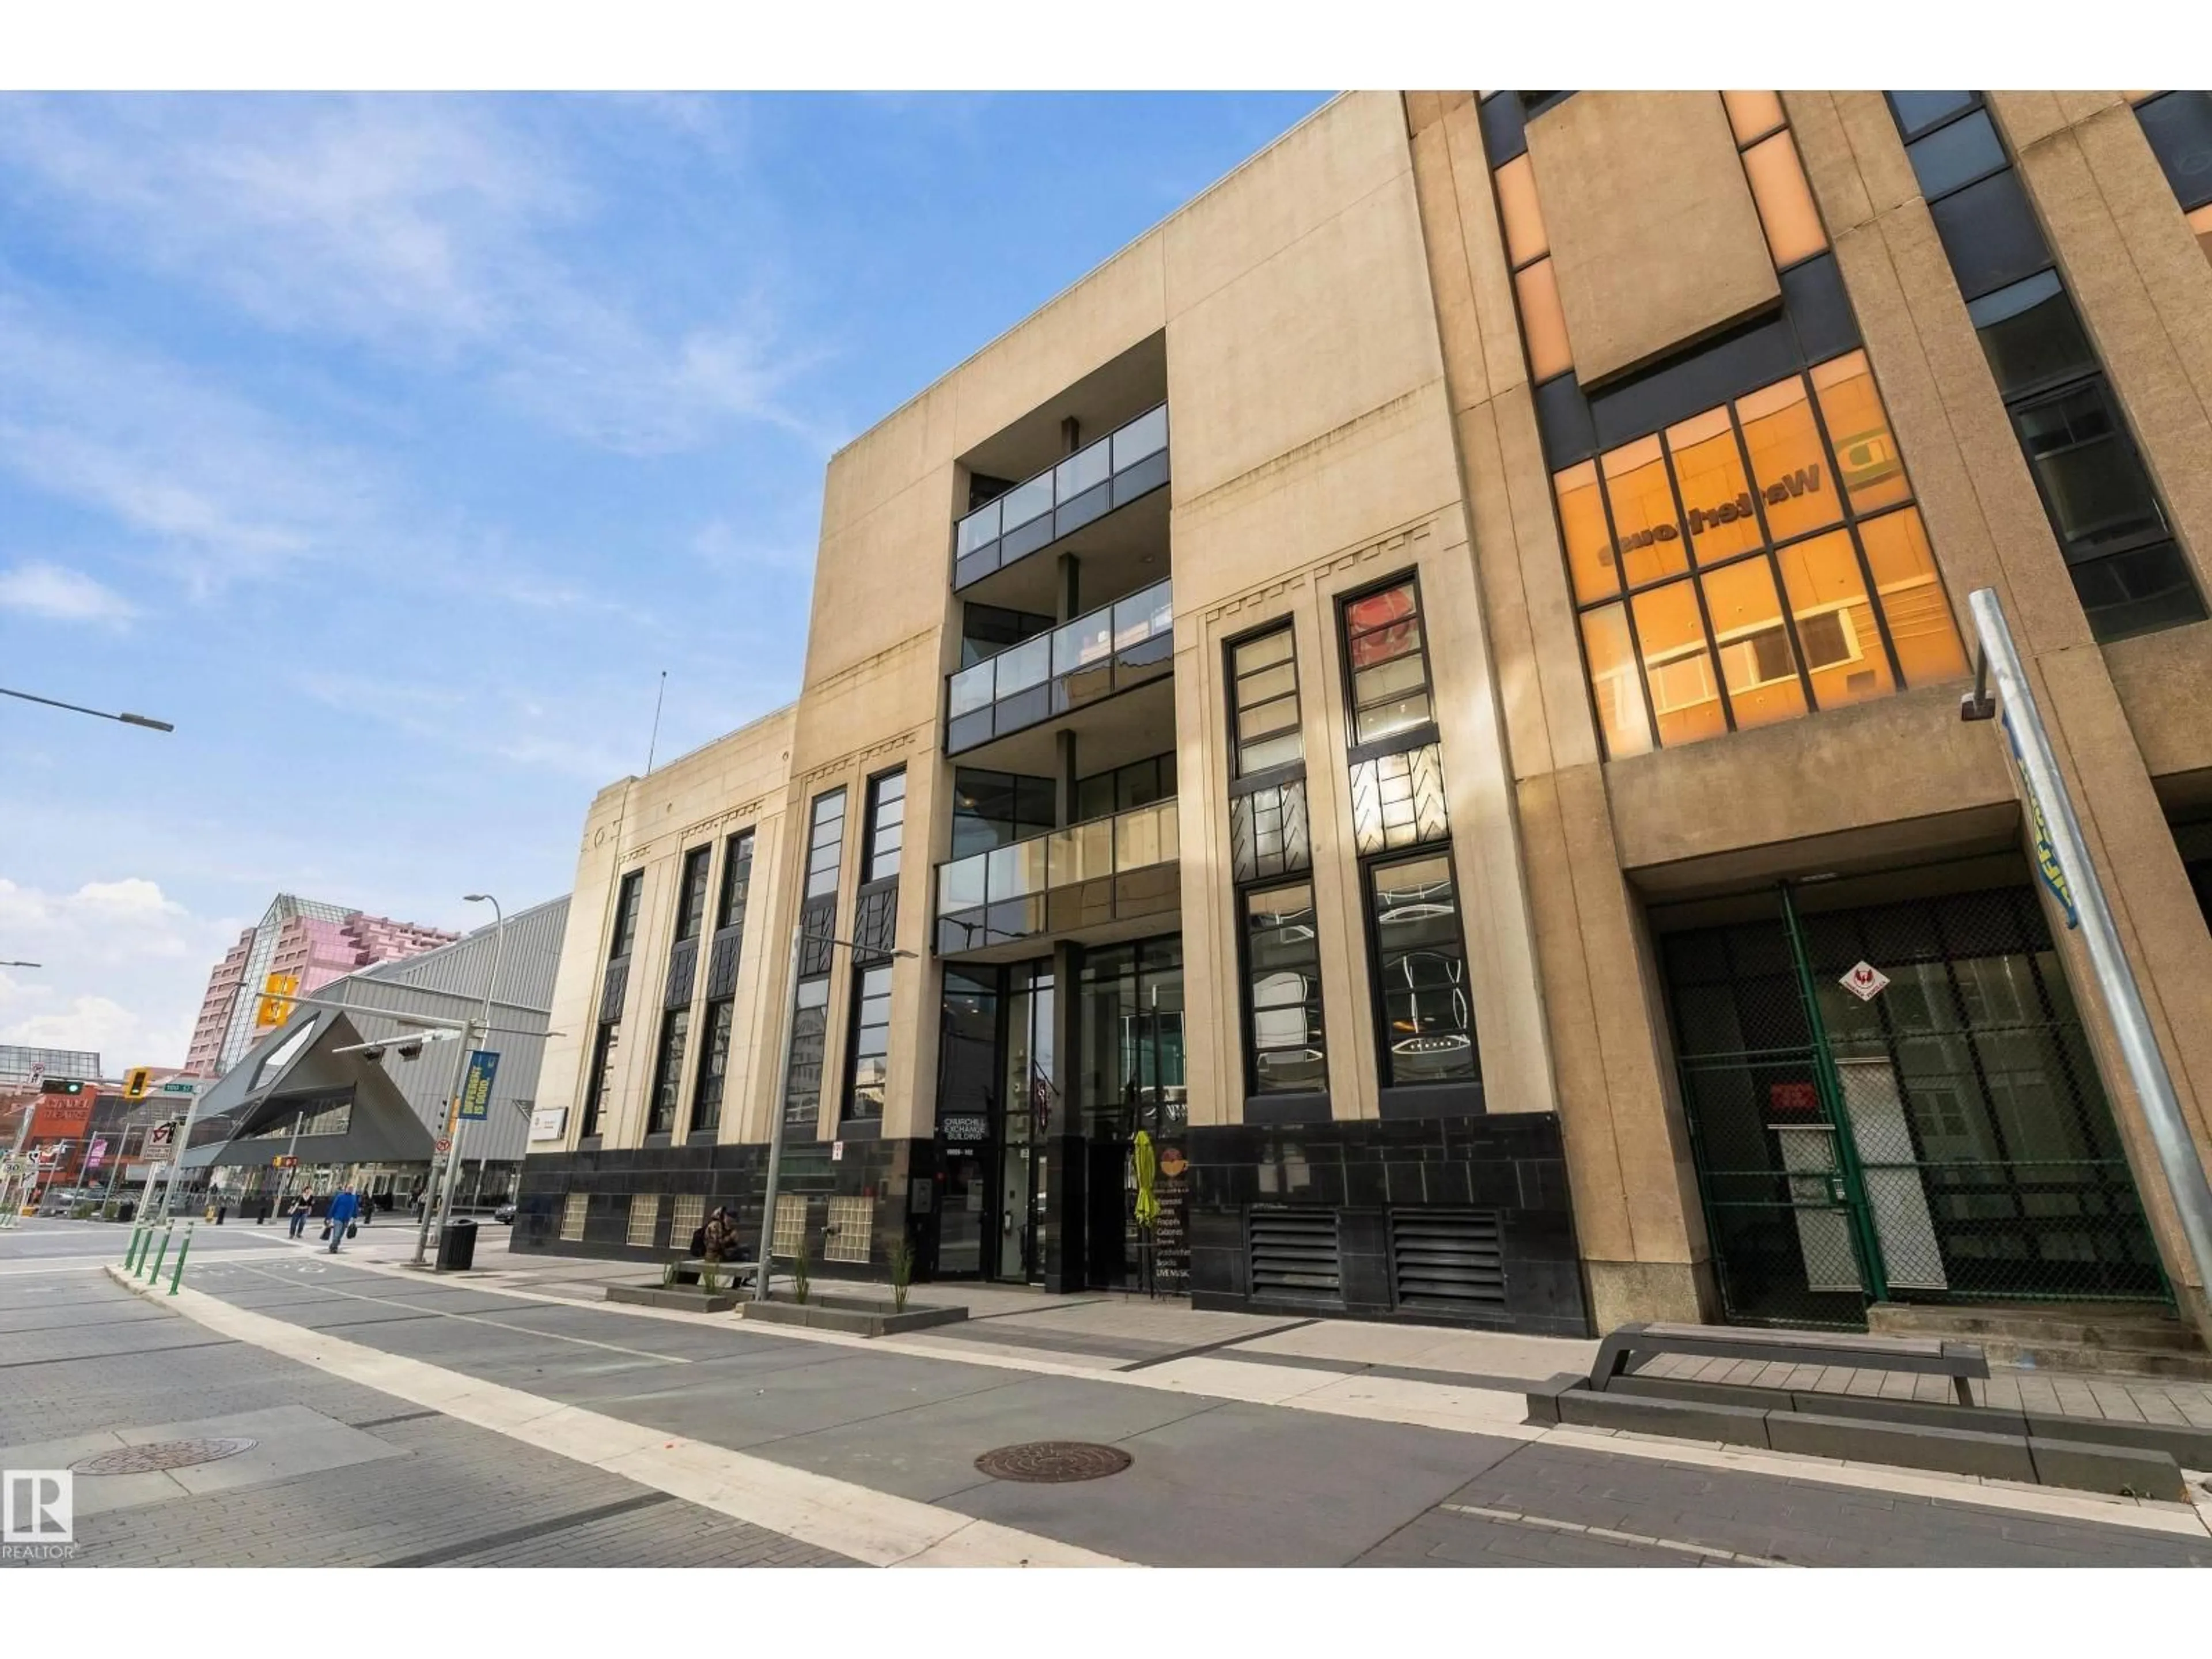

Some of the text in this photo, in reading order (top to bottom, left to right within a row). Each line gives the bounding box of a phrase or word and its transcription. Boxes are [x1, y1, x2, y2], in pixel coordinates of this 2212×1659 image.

[463, 1066, 482, 1114] DIFFERENT
[474, 1105, 484, 1115] IS
[944, 1118, 986, 1126] CHURCHILL
